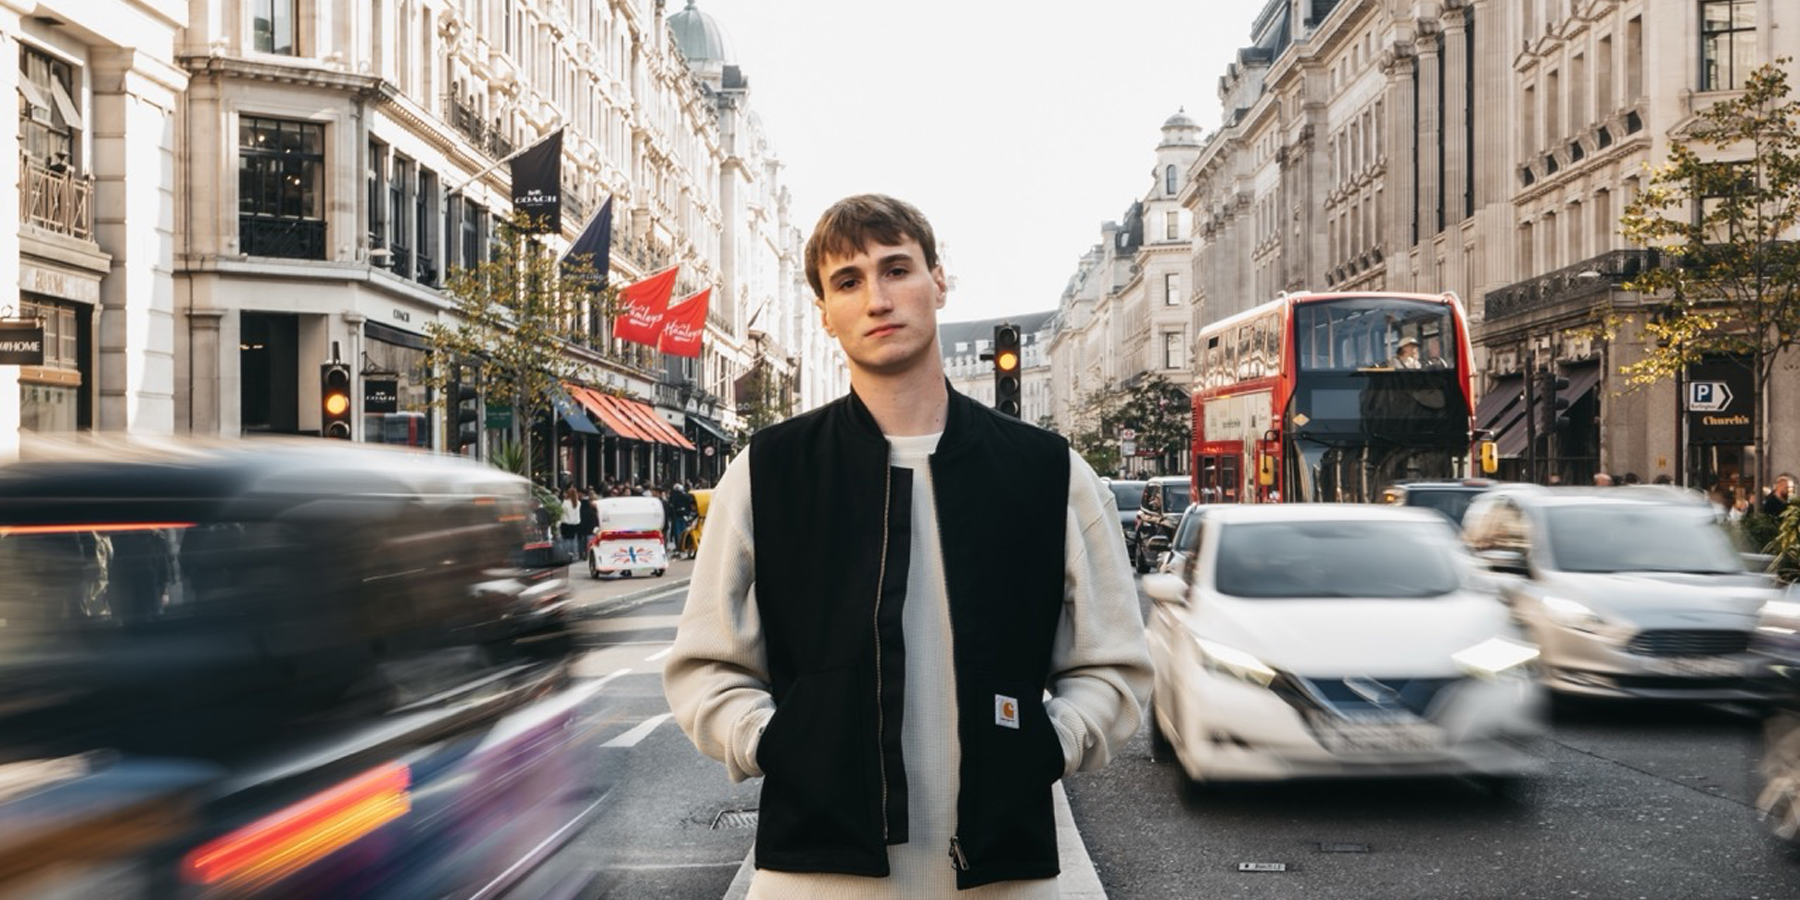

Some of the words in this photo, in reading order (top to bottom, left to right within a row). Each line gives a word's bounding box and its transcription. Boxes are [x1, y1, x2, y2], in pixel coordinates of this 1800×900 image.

[515, 194, 557, 204] COACH
[1697, 385, 1710, 401] P
[1703, 415, 1749, 425] Church's
